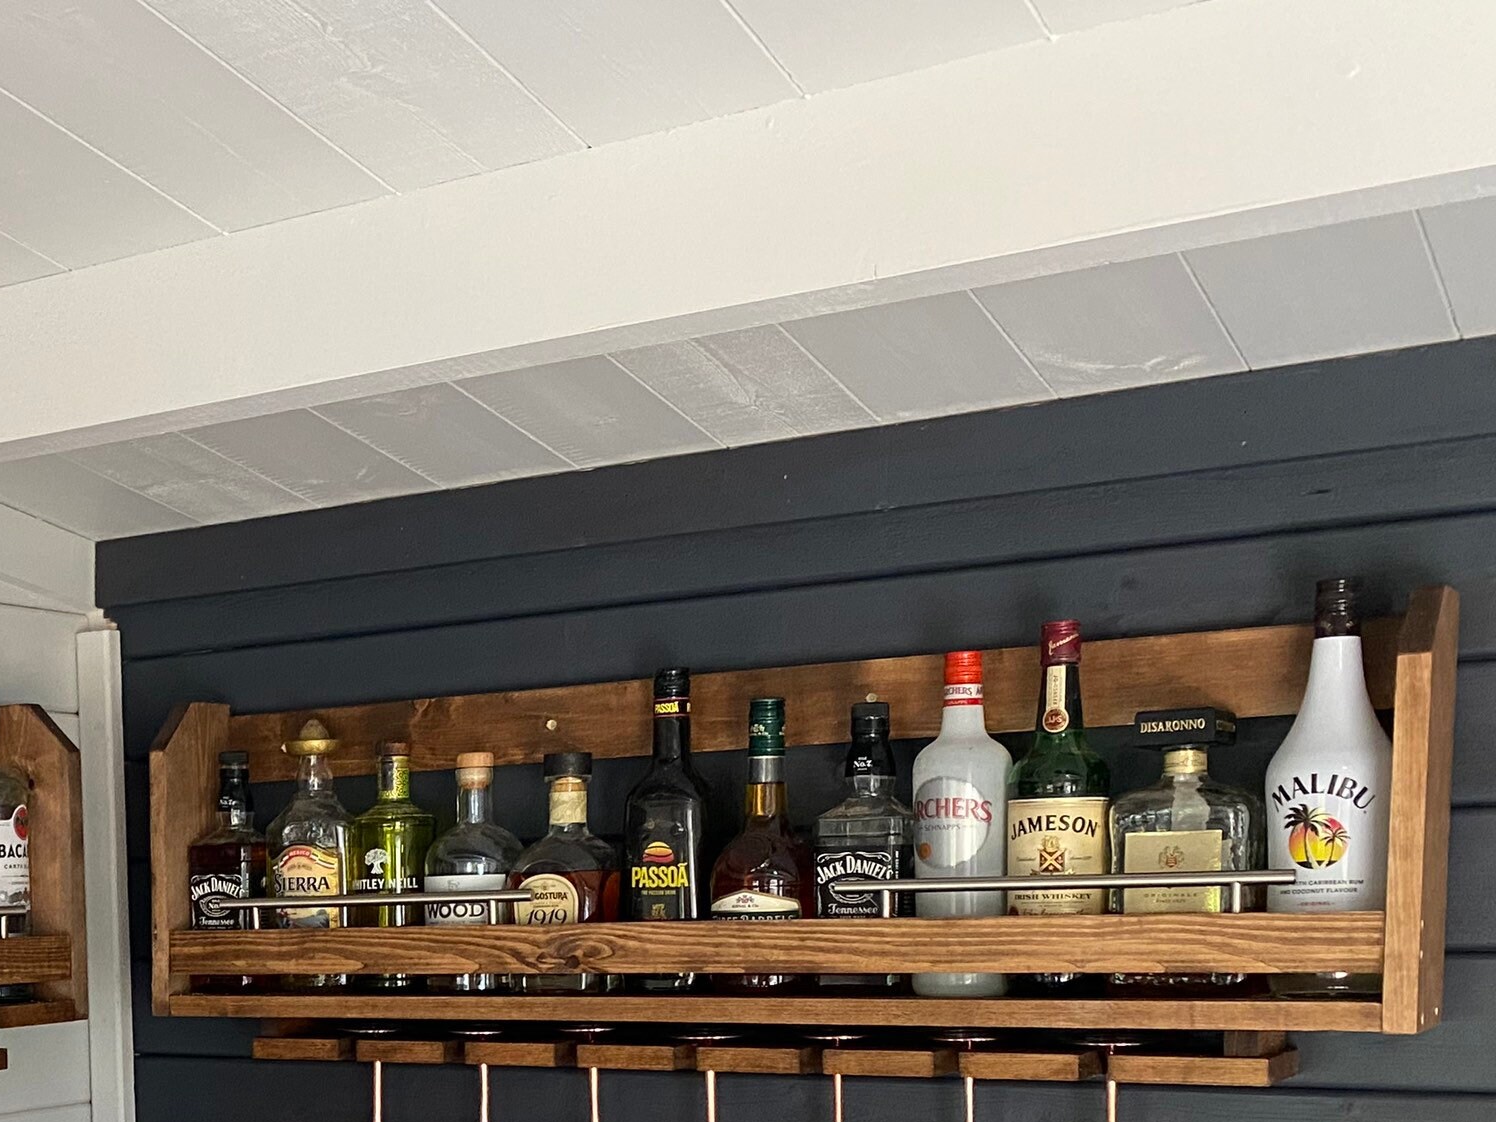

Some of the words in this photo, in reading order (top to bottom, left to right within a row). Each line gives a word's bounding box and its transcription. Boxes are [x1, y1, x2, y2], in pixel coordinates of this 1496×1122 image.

[1140, 718, 1206, 734] DISARONNO
[1272, 773, 1376, 813] MALIBU
[1011, 815, 1099, 841] JAMESON
[817, 860, 846, 885] JACK
[190, 880, 211, 901] JACK
[274, 873, 331, 894] SIERRA
[534, 892, 569, 901] GOSTURA
[1042, 893, 1092, 901] WHISKEY
[526, 908, 568, 925] 1919
[828, 903, 879, 915] Tennessee
